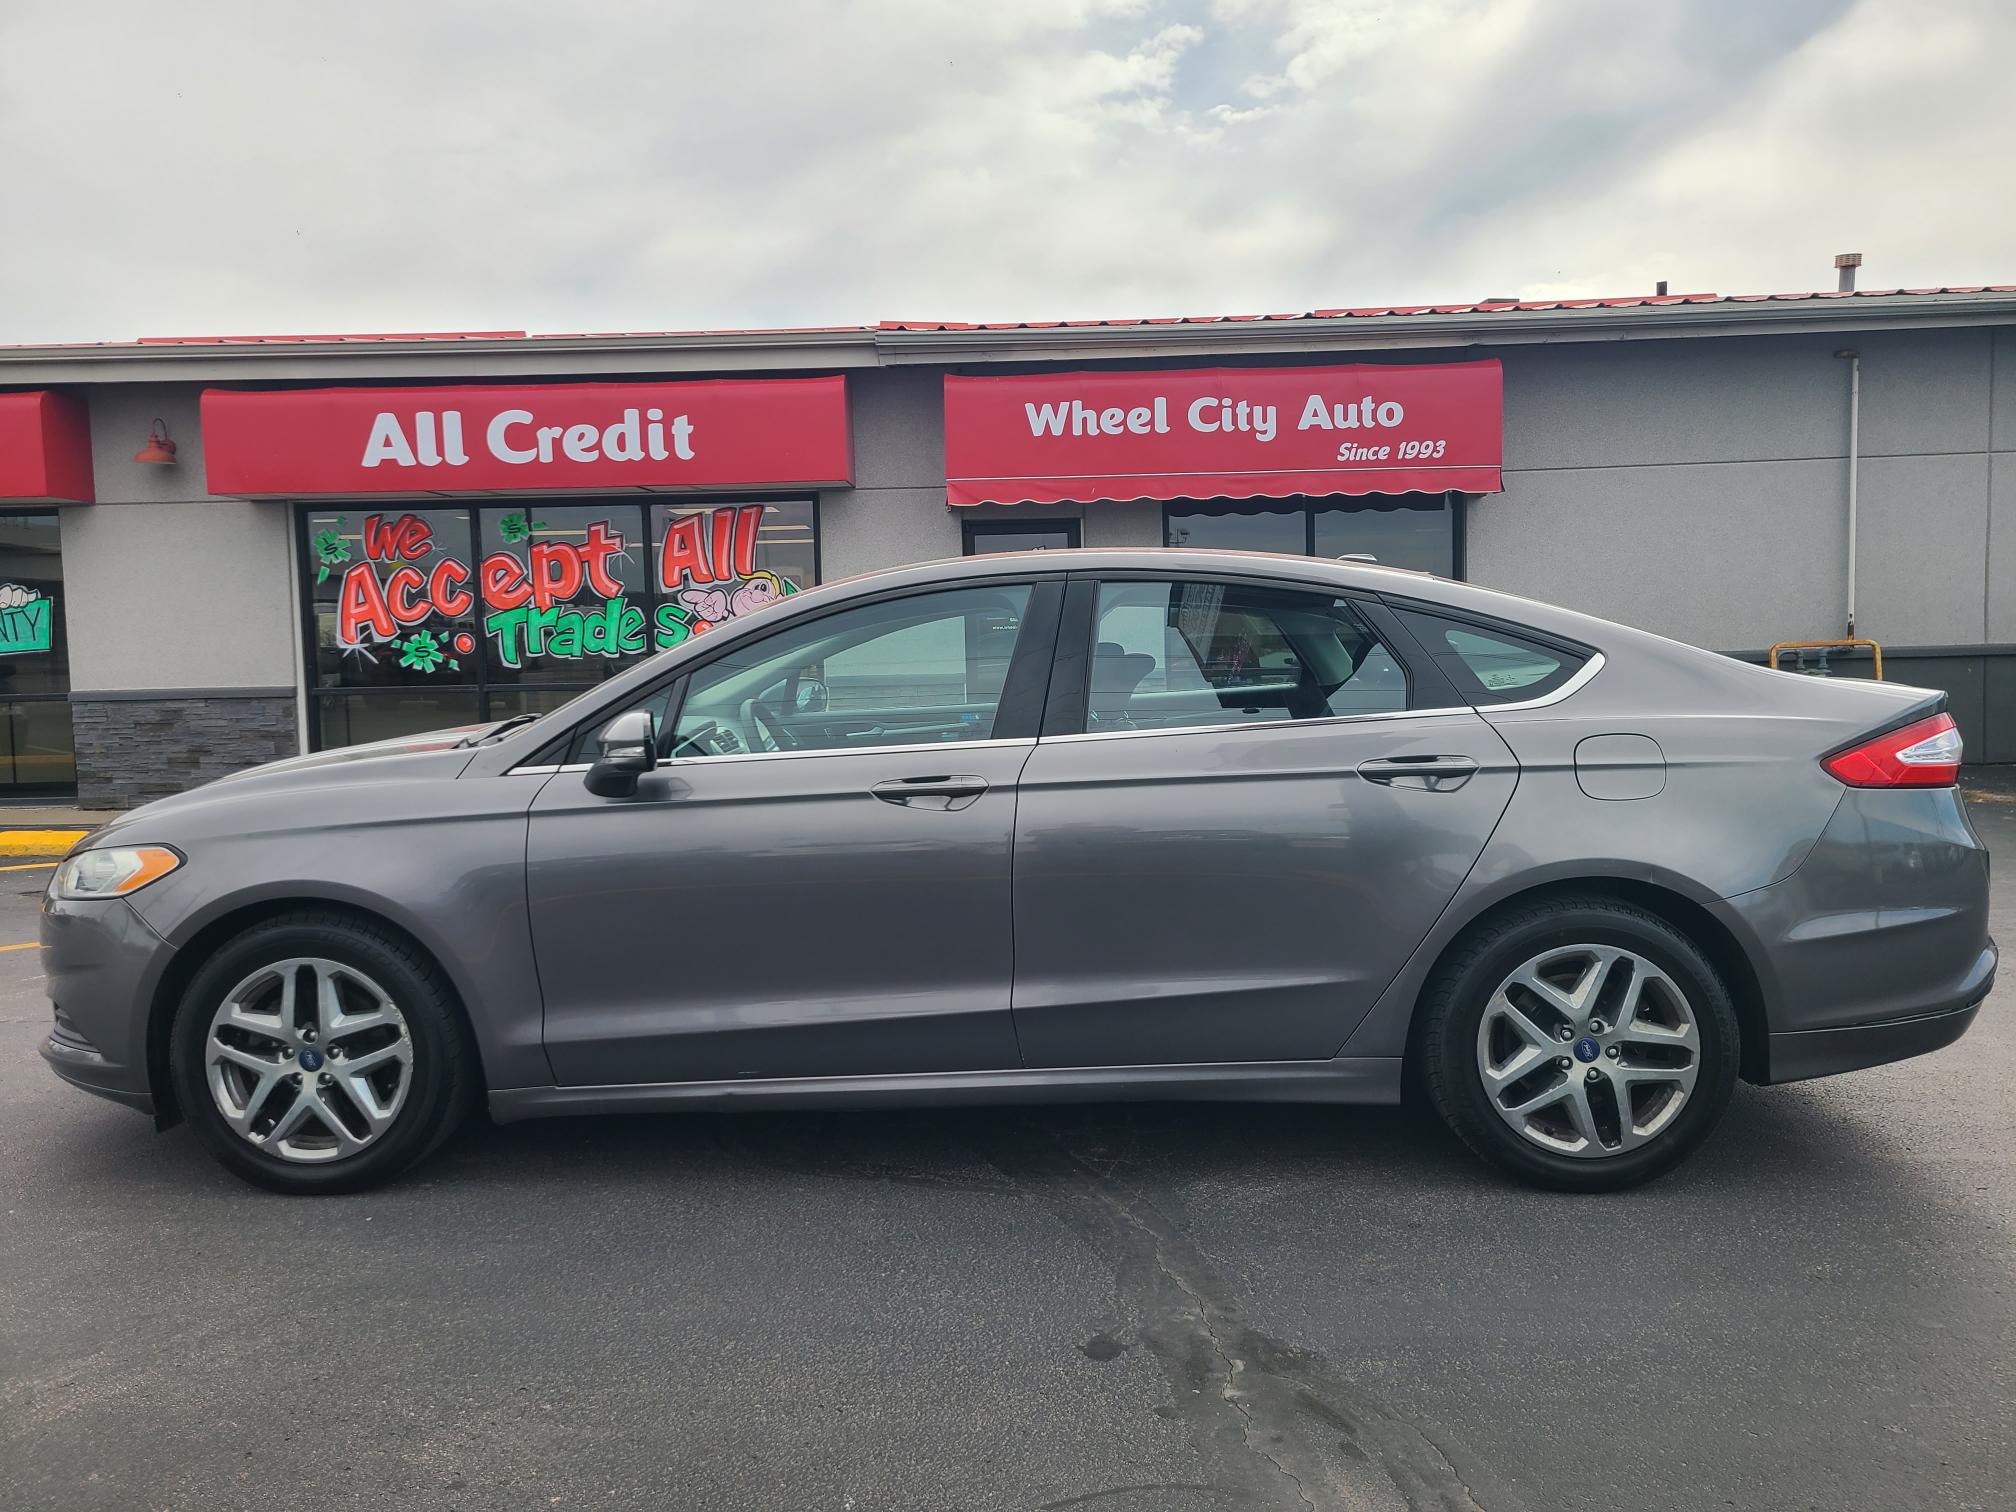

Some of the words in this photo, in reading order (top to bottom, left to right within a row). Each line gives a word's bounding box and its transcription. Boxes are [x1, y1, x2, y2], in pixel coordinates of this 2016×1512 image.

[361, 410, 469, 467] All
[486, 408, 695, 464] Credit
[1025, 397, 1171, 437] Wheel
[1187, 397, 1277, 441] City
[1297, 394, 1404, 430] Auto
[1336, 442, 1389, 461] Since
[1397, 439, 1446, 460] 1993
[363, 512, 434, 562] We
[338, 522, 625, 646] Accept
[662, 505, 764, 589] All
